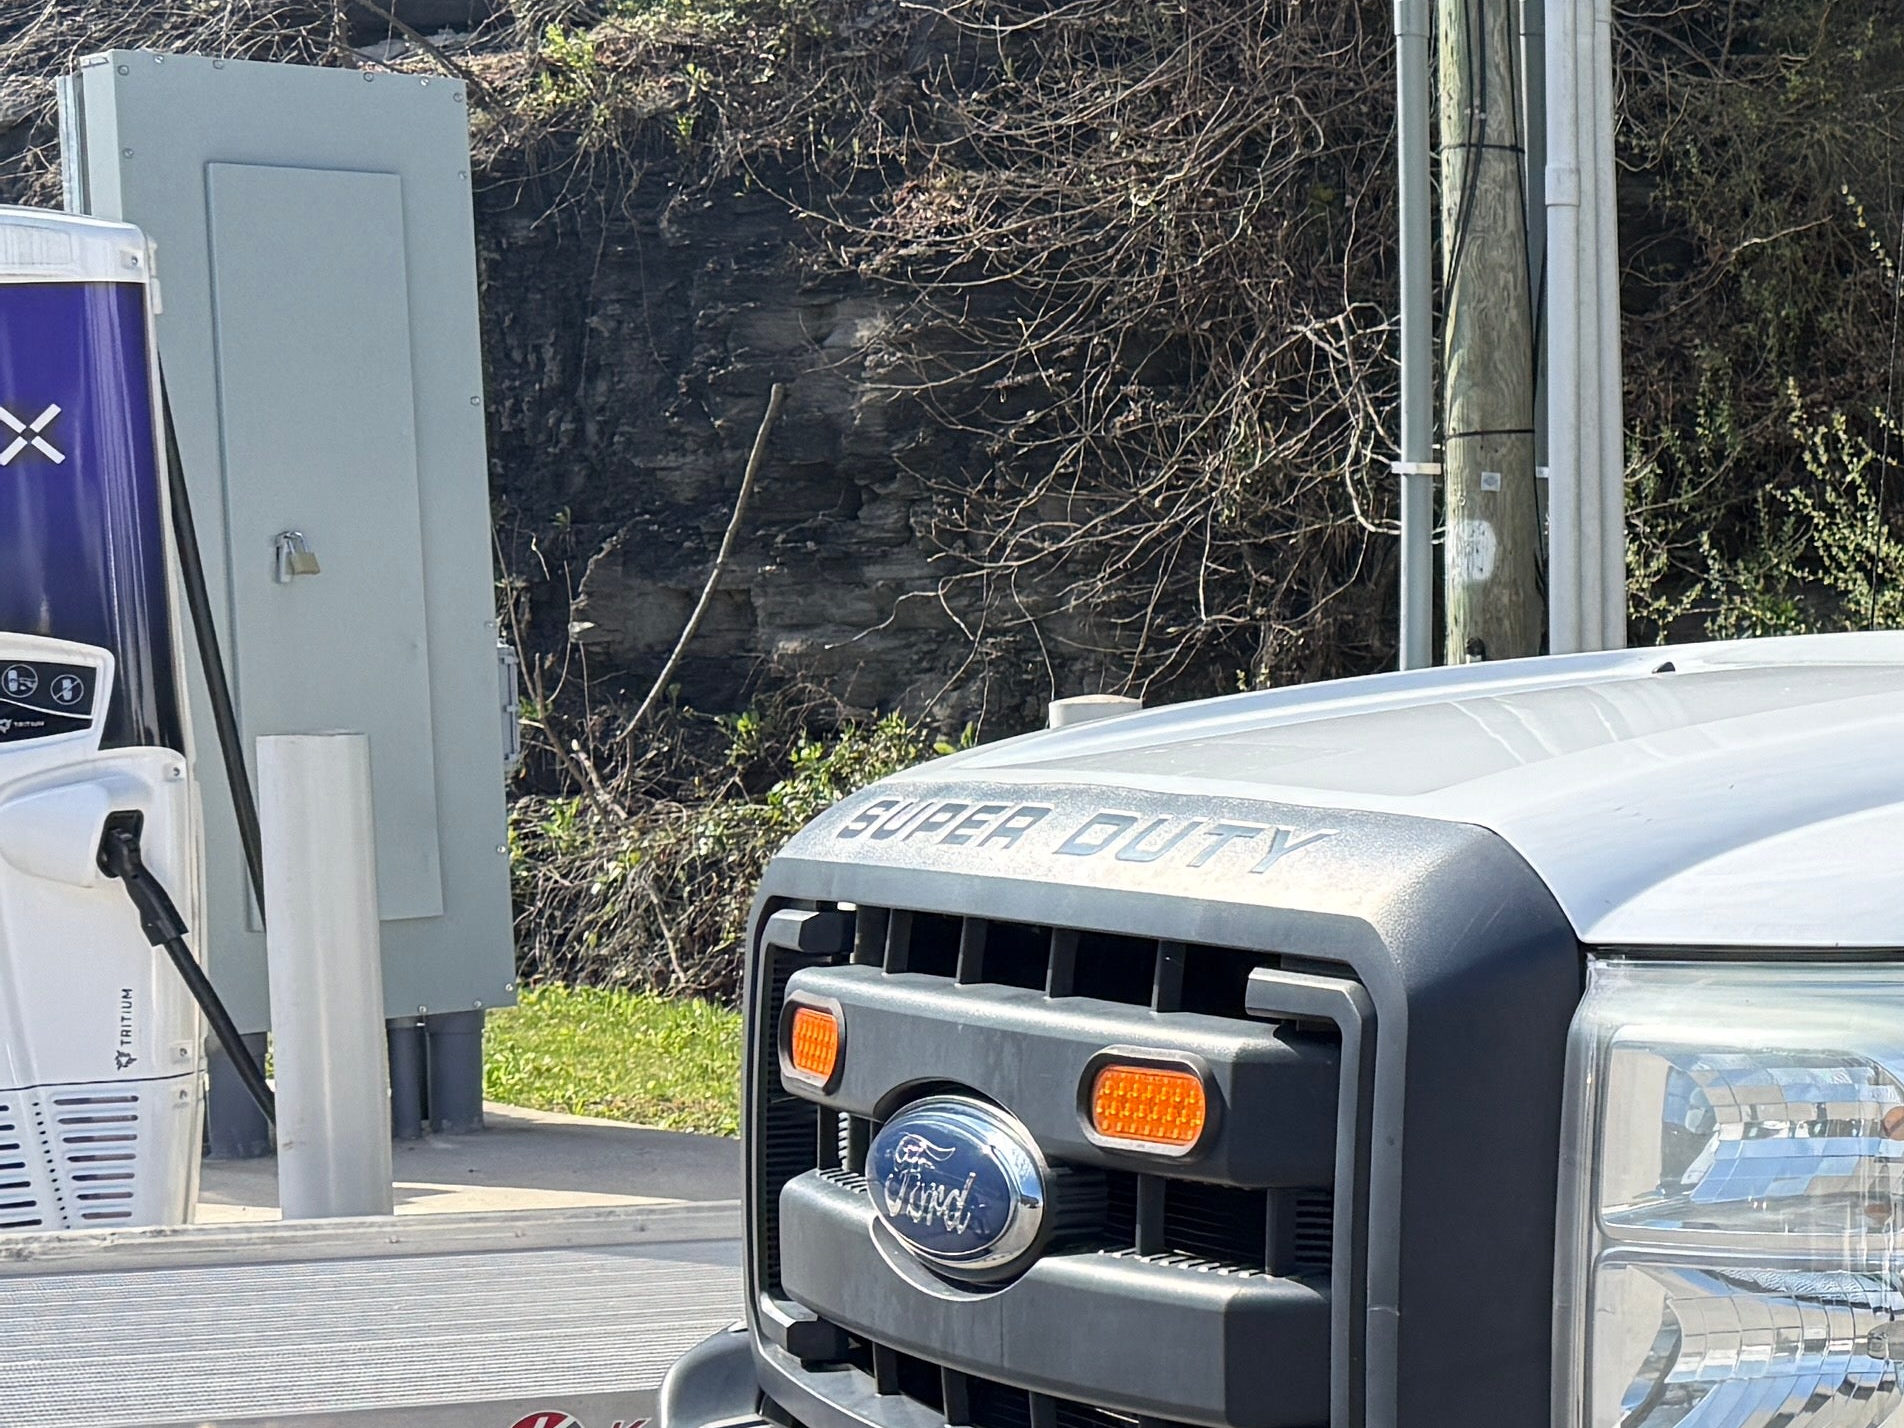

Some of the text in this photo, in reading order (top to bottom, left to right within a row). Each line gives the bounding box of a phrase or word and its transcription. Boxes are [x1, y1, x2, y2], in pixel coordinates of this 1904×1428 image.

[836, 799, 1340, 875] SUPER DUTY
[120, 988, 133, 1047] TRITIUM
[884, 1132, 977, 1235] Ford
